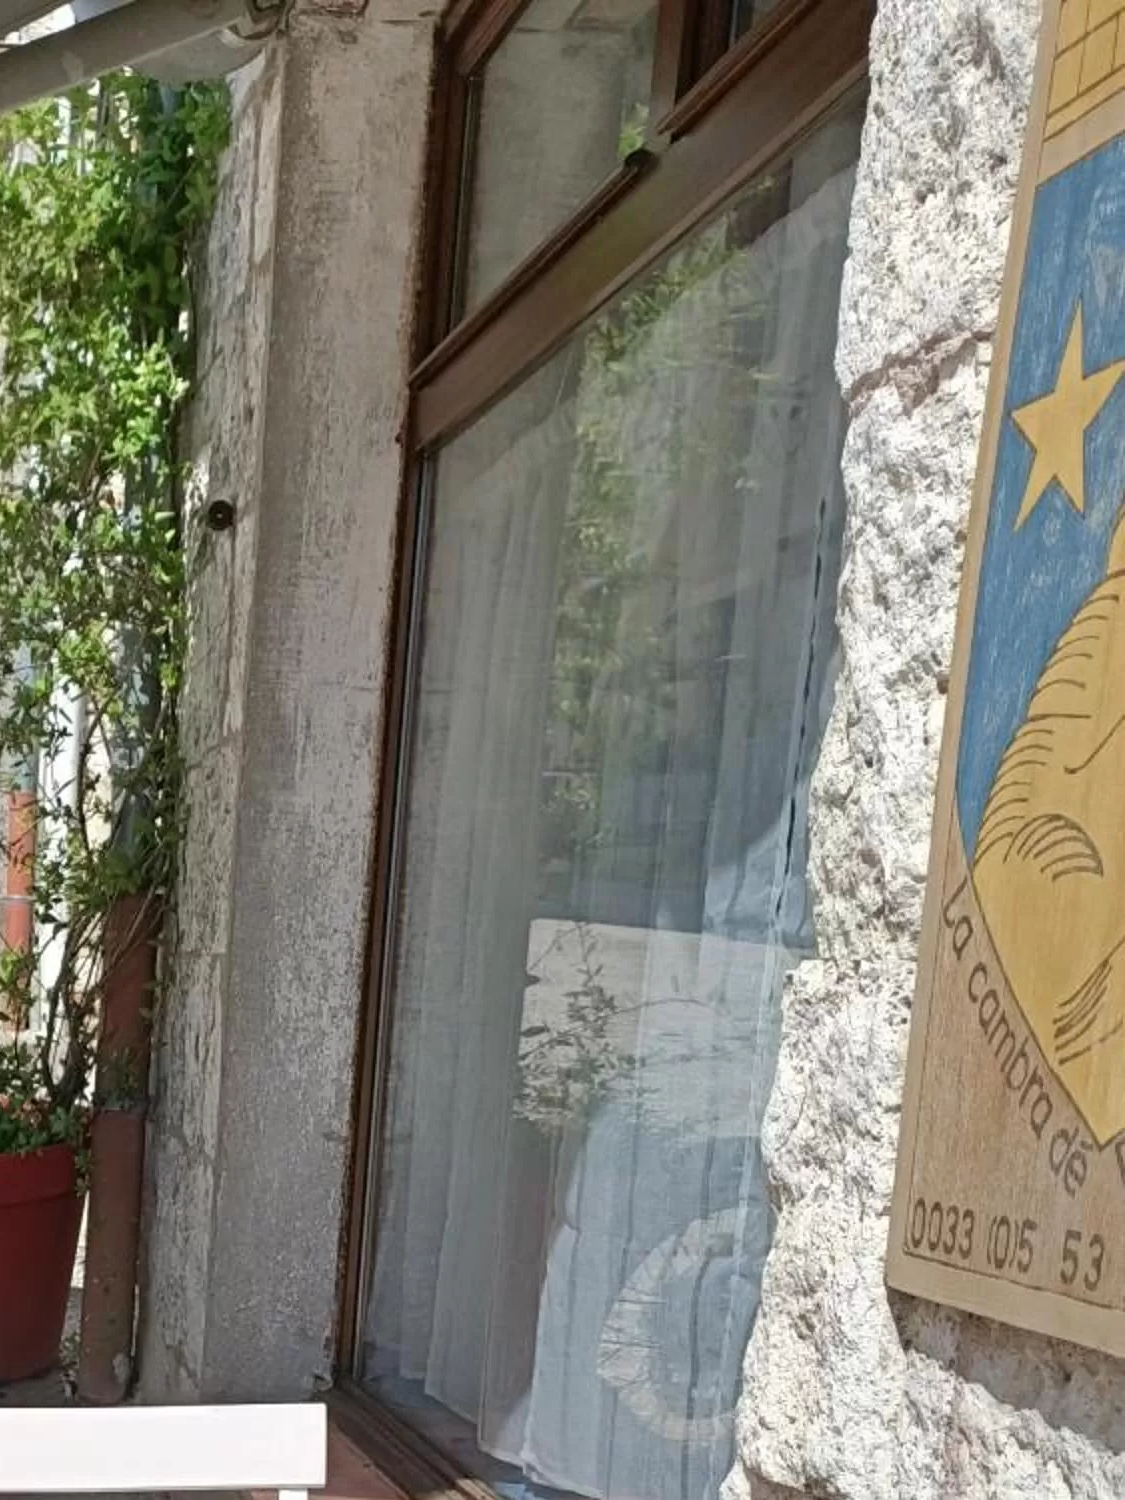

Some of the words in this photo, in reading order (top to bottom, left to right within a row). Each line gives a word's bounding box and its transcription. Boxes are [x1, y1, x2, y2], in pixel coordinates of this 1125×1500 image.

[942, 875, 974, 961] la
[967, 961, 1054, 1141] cambra
[910, 1197, 975, 1260] 0033
[986, 1215, 1038, 1273] (0)5
[1059, 1229, 1105, 1292] 53
